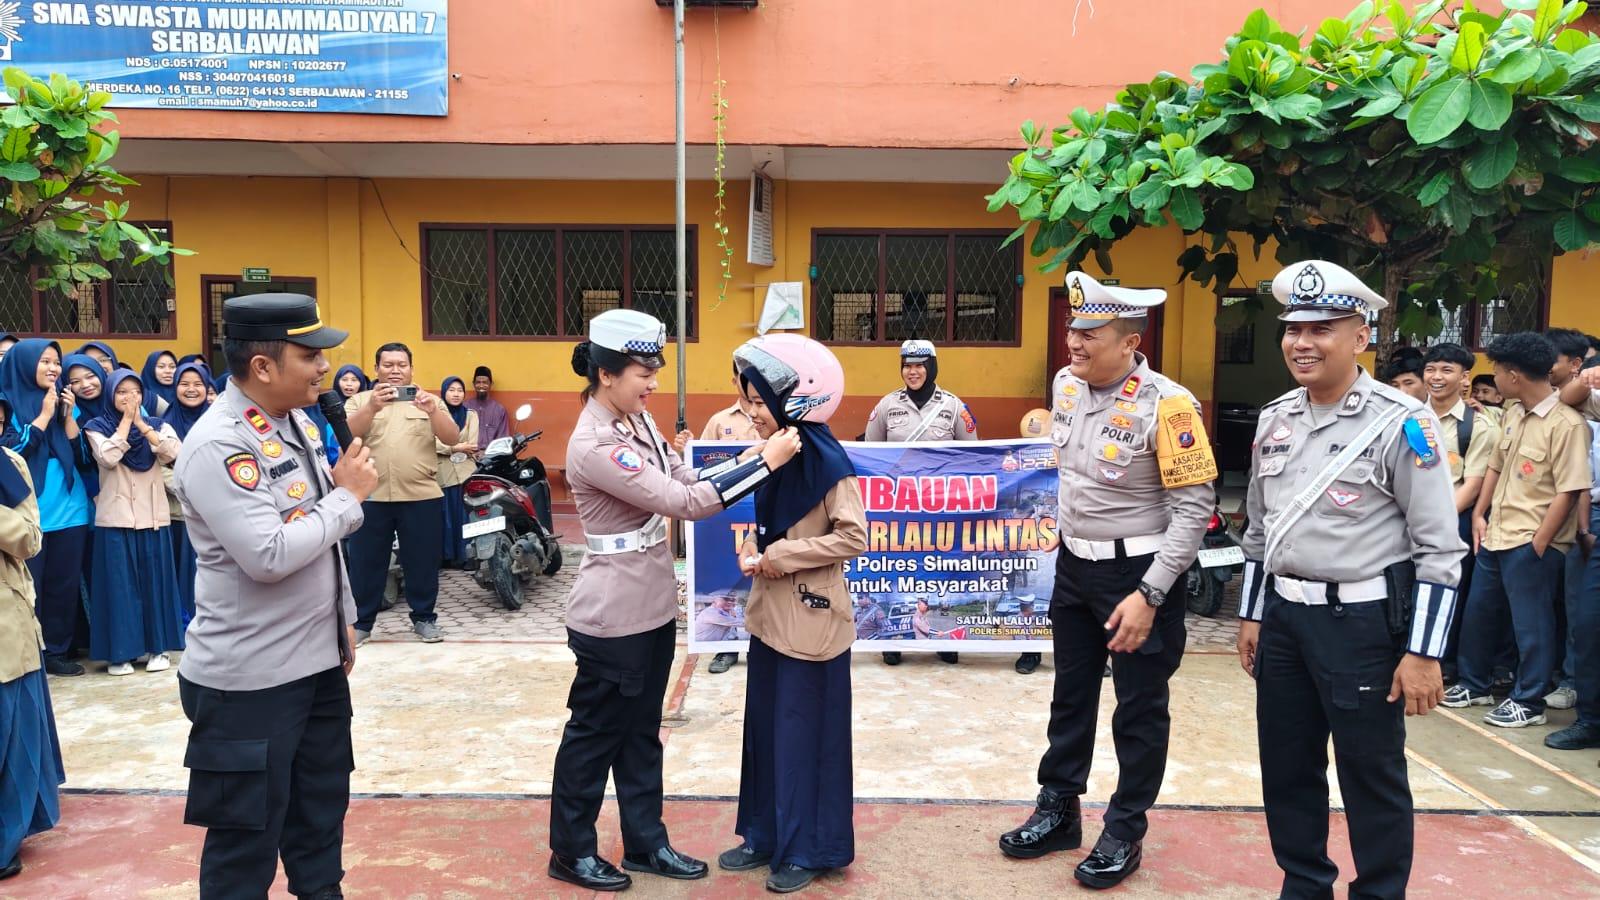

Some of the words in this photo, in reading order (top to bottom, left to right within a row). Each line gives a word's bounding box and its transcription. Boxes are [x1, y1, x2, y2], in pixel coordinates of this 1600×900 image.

[32, 2, 91, 26] SMA
[94, 4, 203, 29] SWASTA
[207, 7, 417, 34] MUHAMMADIYAH
[421, 11, 436, 35] 7
[151, 30, 320, 55] SERBALAWAN
[126, 57, 151, 68] NDS
[161, 58, 228, 69] G.05174001
[248, 60, 281, 70] NPSN
[291, 61, 346, 71] 10202677
[179, 71, 202, 81] NSS
[212, 72, 295, 83] 304070416018
[144, 85, 164, 95] NO.
[168, 85, 181, 95] 16
[184, 85, 213, 95] TELP.
[216, 85, 250, 97] (0622)
[252, 87, 286, 97] 64143
[288, 87, 366, 98] SERBALAWAN
[375, 90, 409, 99] 21155
[158, 97, 189, 106] email
[198, 97, 318, 108] smamuh7@yahoo.co.id
[1101, 426, 1135, 445] POLRI
[858, 475, 998, 513] BAUAN
[961, 517, 1059, 552] LINTAS
[857, 556, 917, 572] Polres
[923, 555, 1037, 576] Simalungun
[845, 577, 891, 593] ntuk
[898, 577, 1009, 596] Masyarakat
[956, 616, 1001, 626] SATUAN
[1004, 616, 1034, 626] LALU
[969, 627, 1002, 635] POLRES
[1005, 628, 1053, 636] SIMALUNGU
